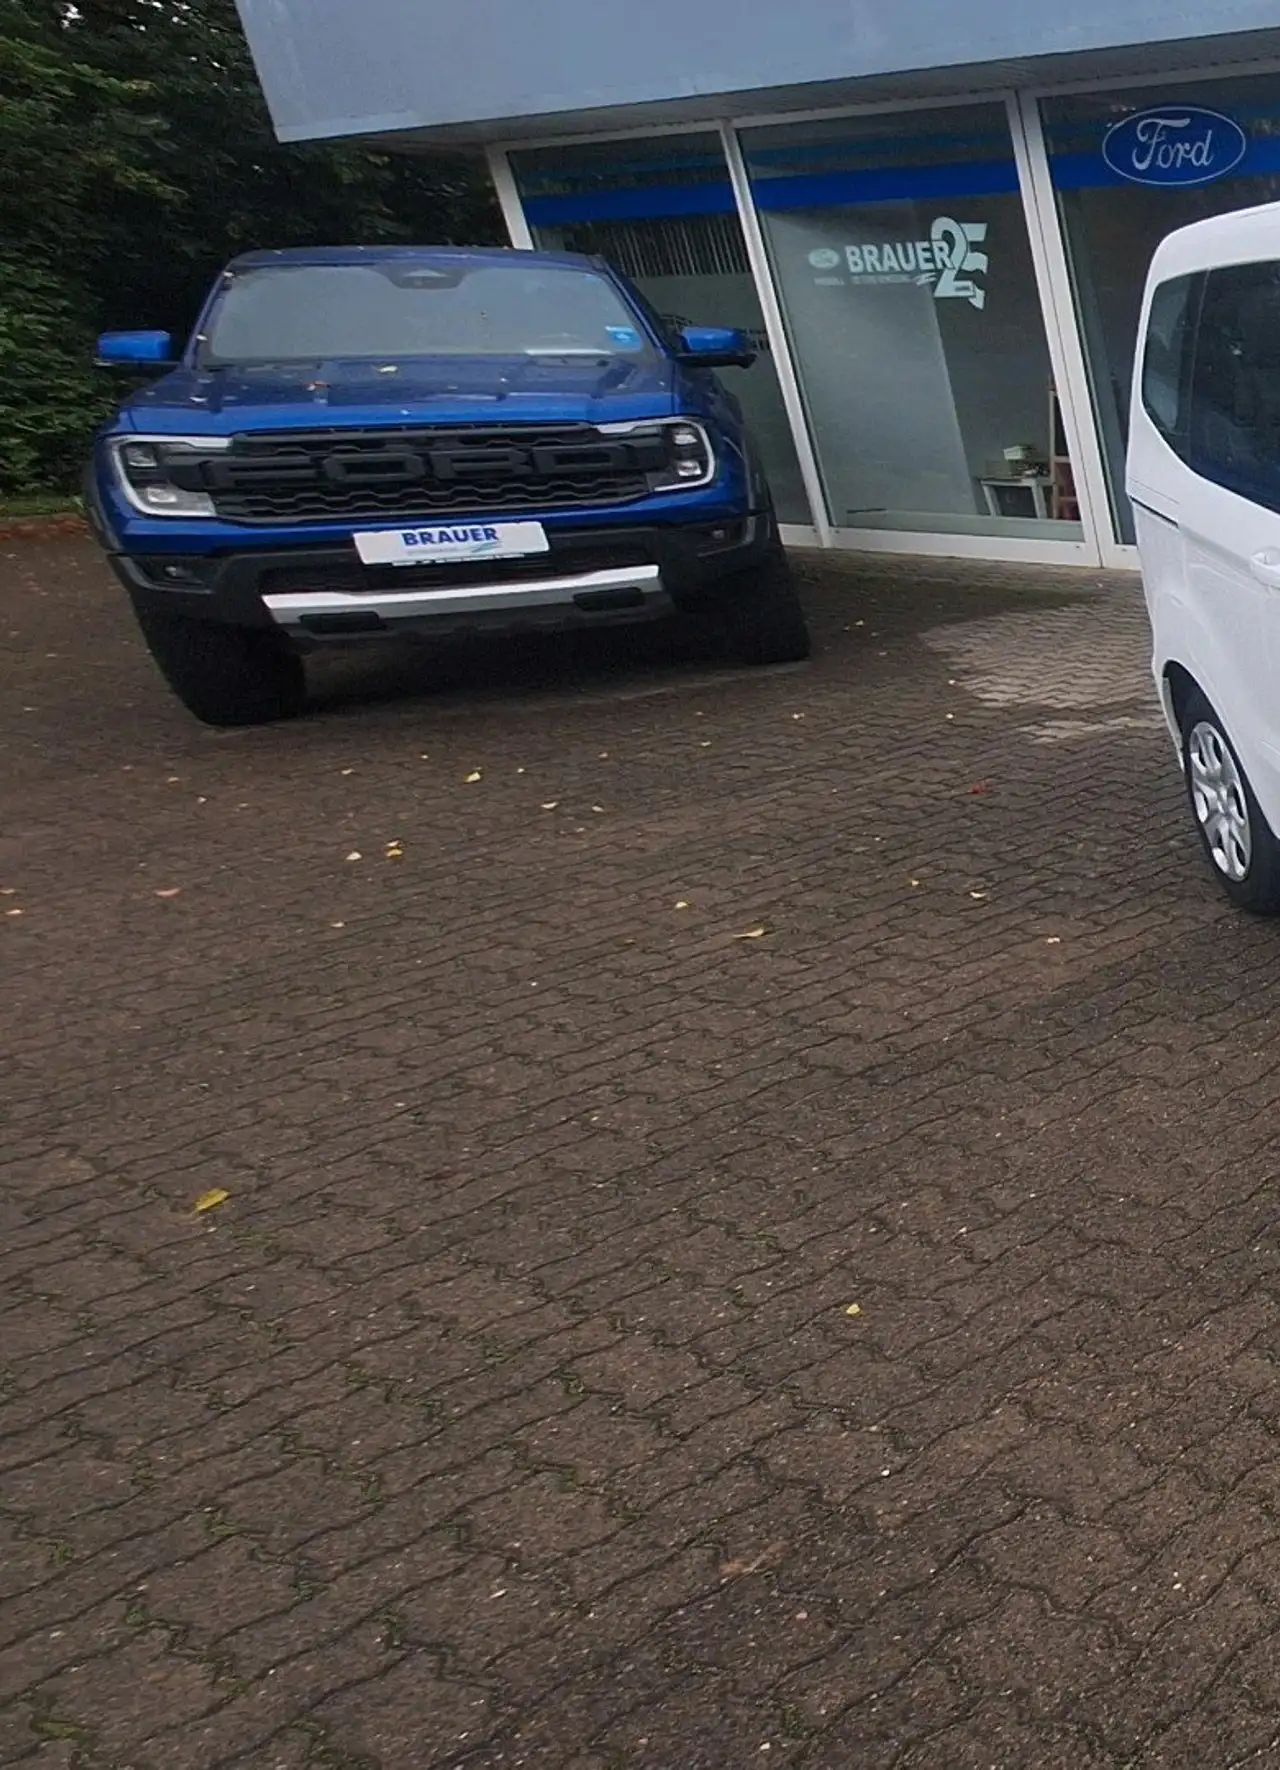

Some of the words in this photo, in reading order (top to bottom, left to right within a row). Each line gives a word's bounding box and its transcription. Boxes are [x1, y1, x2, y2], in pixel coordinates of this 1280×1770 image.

[1131, 118, 1215, 171] Ford
[844, 240, 956, 273] BRAUER
[401, 528, 499, 546] BRAUER
